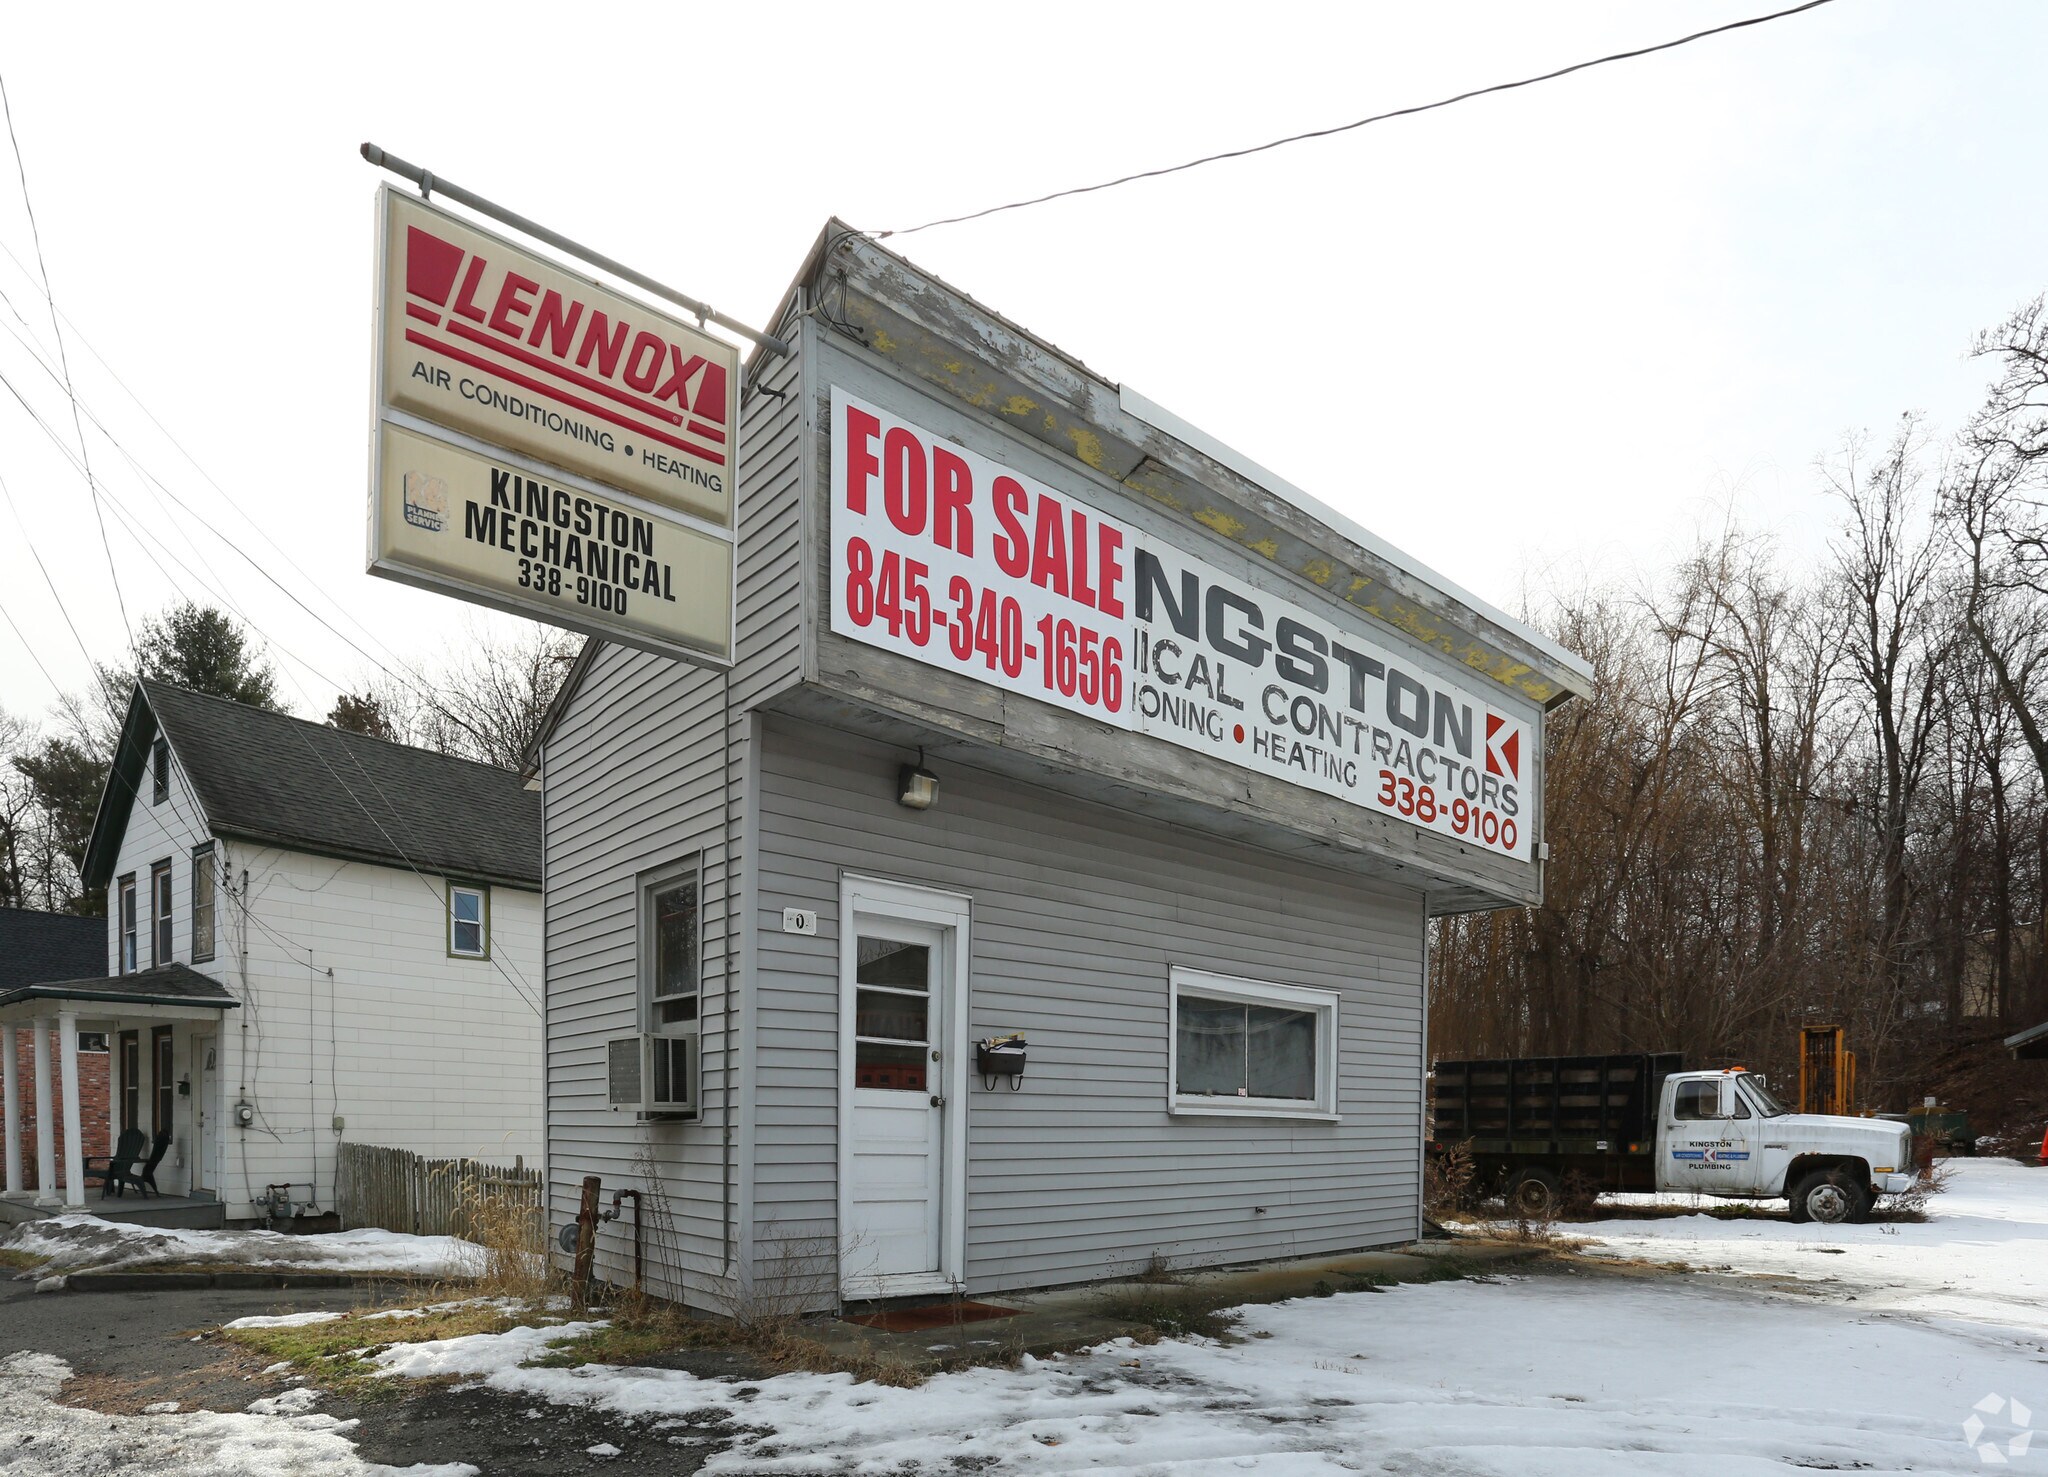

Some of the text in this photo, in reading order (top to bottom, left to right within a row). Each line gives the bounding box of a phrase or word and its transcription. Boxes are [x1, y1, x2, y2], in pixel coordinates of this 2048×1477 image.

[453, 255, 708, 411] LENNOX
[412, 361, 723, 493] AIR CONDITIONING HEATING
[465, 501, 676, 602] MECHANICAL
[491, 468, 653, 556] KINGSTON
[846, 404, 1124, 620] FOR SALE
[518, 557, 628, 616] 338-9100
[846, 536, 1123, 714] 845-340-1656
[1134, 547, 1473, 760] NGSTON
[1133, 627, 1520, 817] ICAL CONTRACTORS
[1253, 725, 1358, 789] HEATING
[1377, 769, 1518, 851] 338-9100
